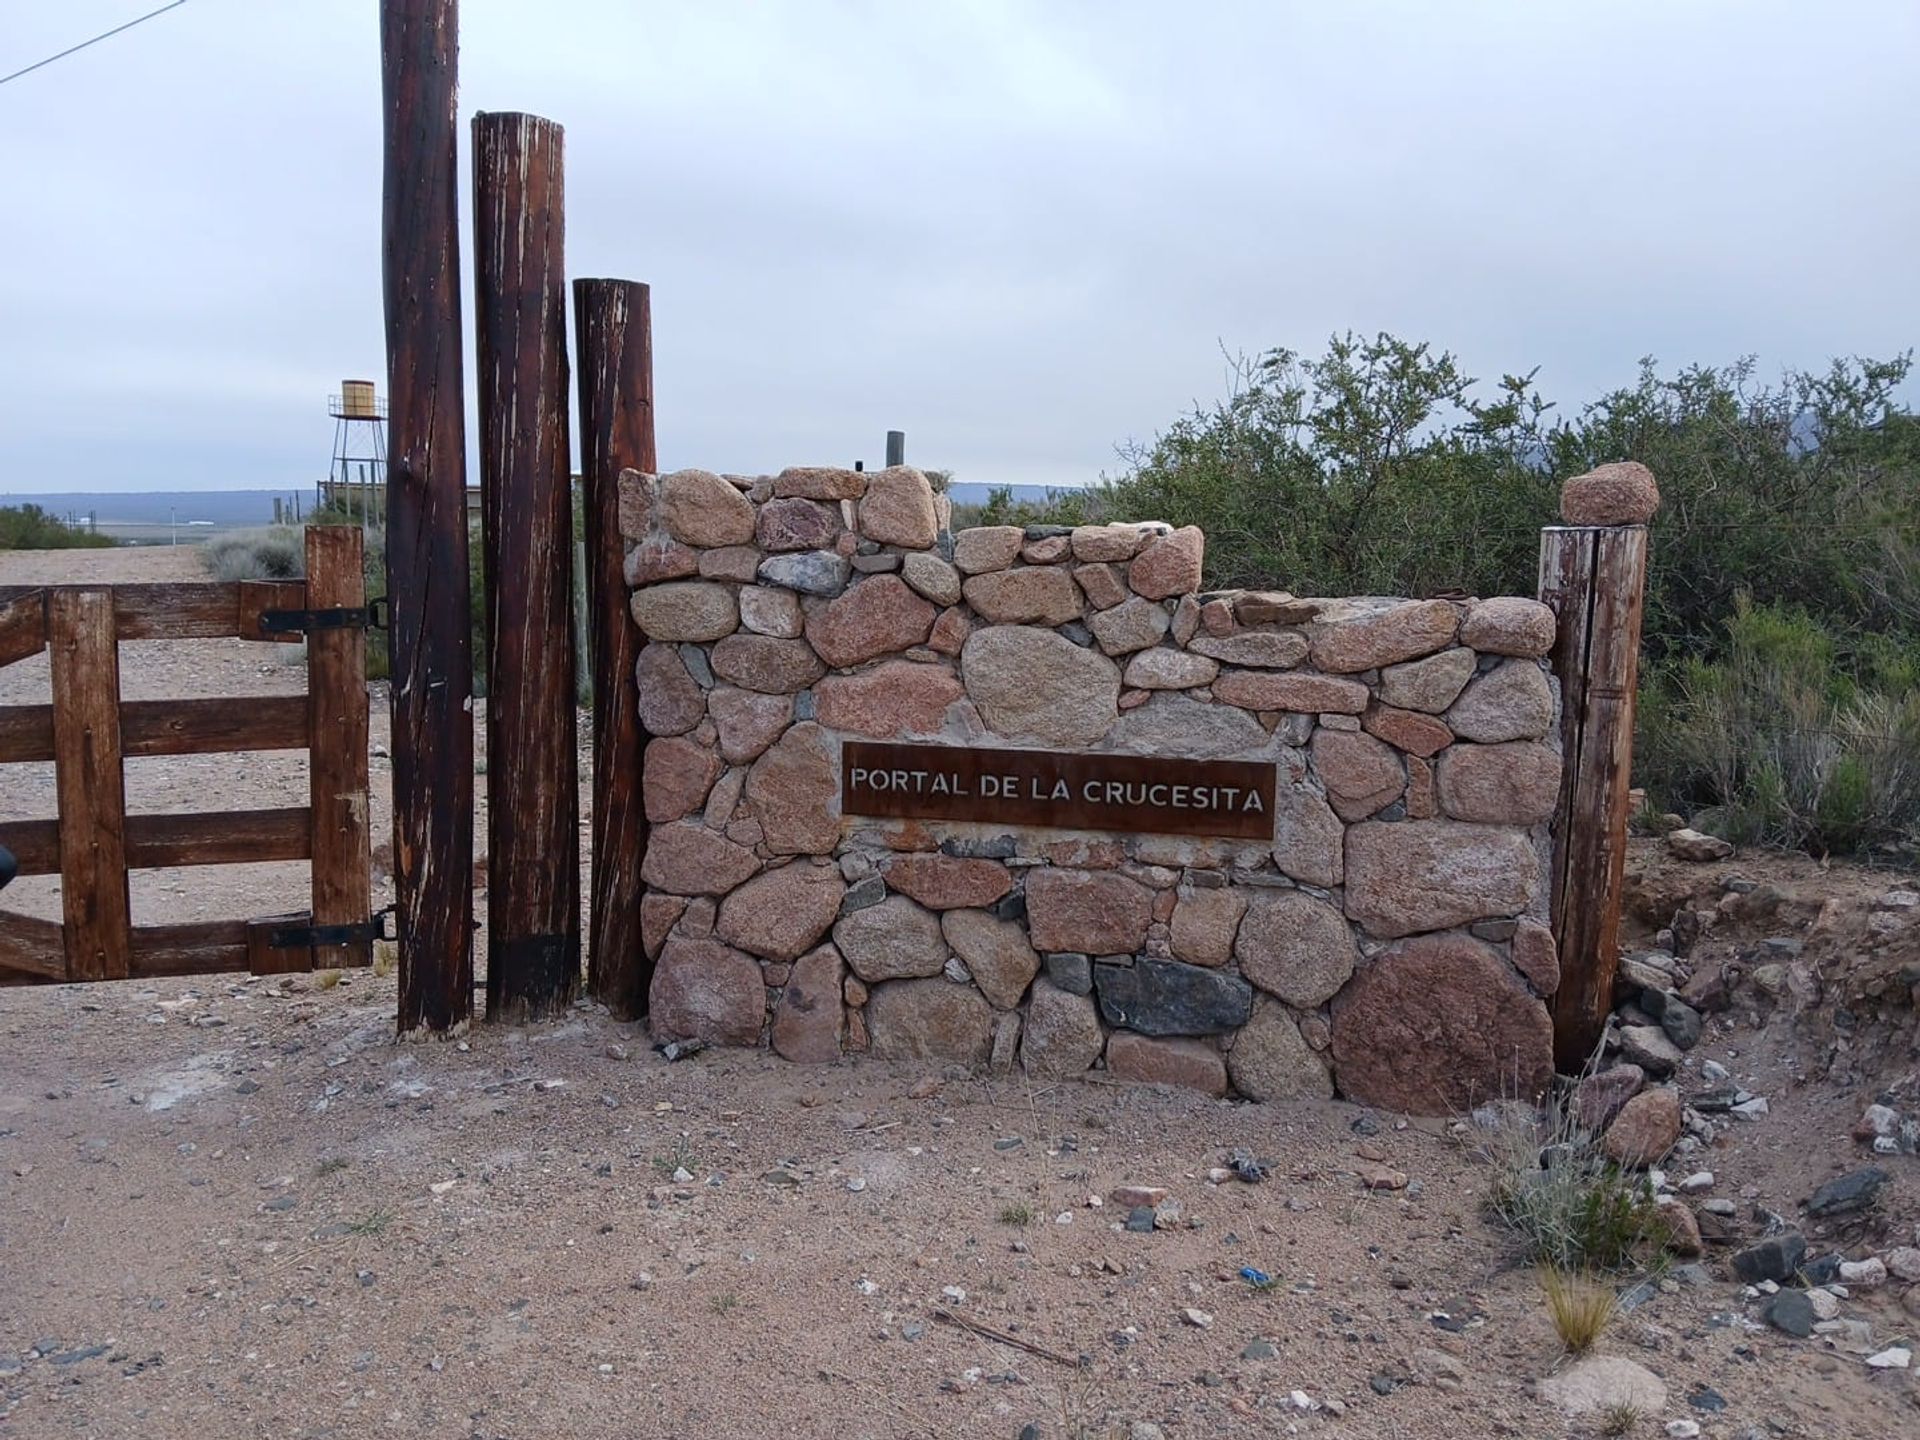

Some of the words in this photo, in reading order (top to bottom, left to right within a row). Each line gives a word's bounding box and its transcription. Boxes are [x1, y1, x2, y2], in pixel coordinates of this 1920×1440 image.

[849, 767, 969, 796] PORTAL
[979, 775, 1020, 798] DE
[1031, 779, 1071, 802] LA
[1082, 780, 1265, 813] CRUCESITA
